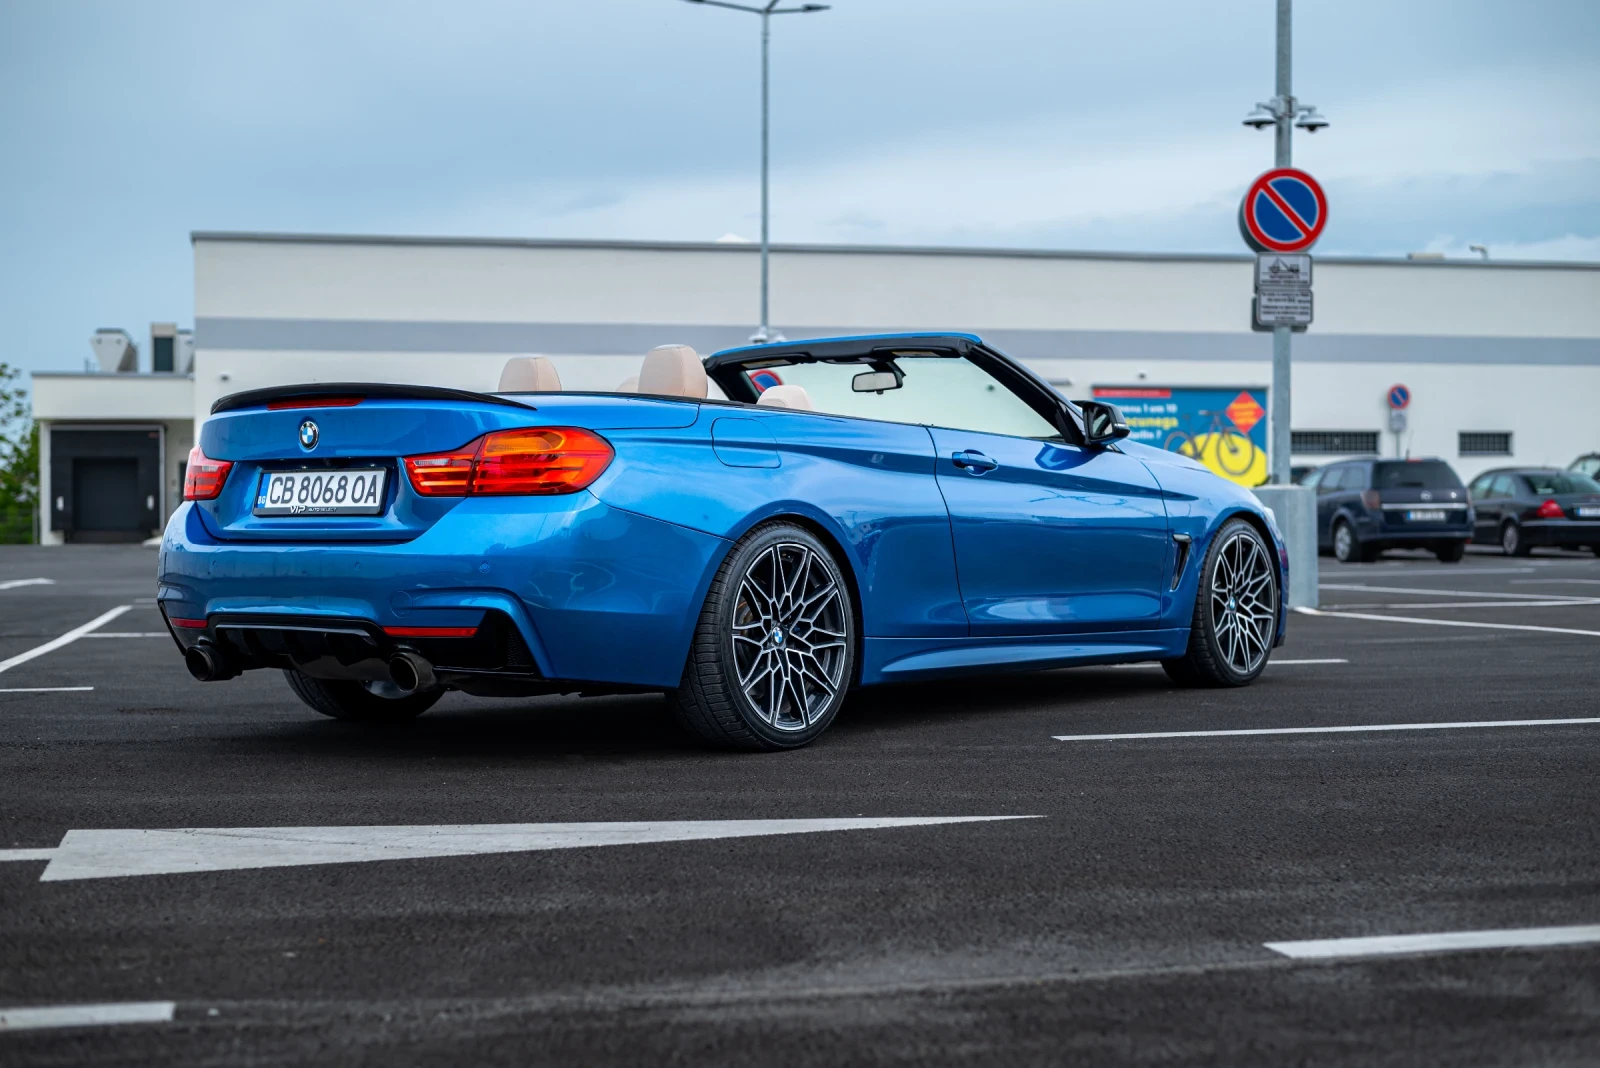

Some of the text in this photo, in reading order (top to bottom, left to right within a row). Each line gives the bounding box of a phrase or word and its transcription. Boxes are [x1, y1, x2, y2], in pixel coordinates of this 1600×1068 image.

[269, 476, 296, 504] CB
[297, 475, 348, 504] 8068
[257, 495, 266, 505] BG
[290, 505, 306, 514] VIP
